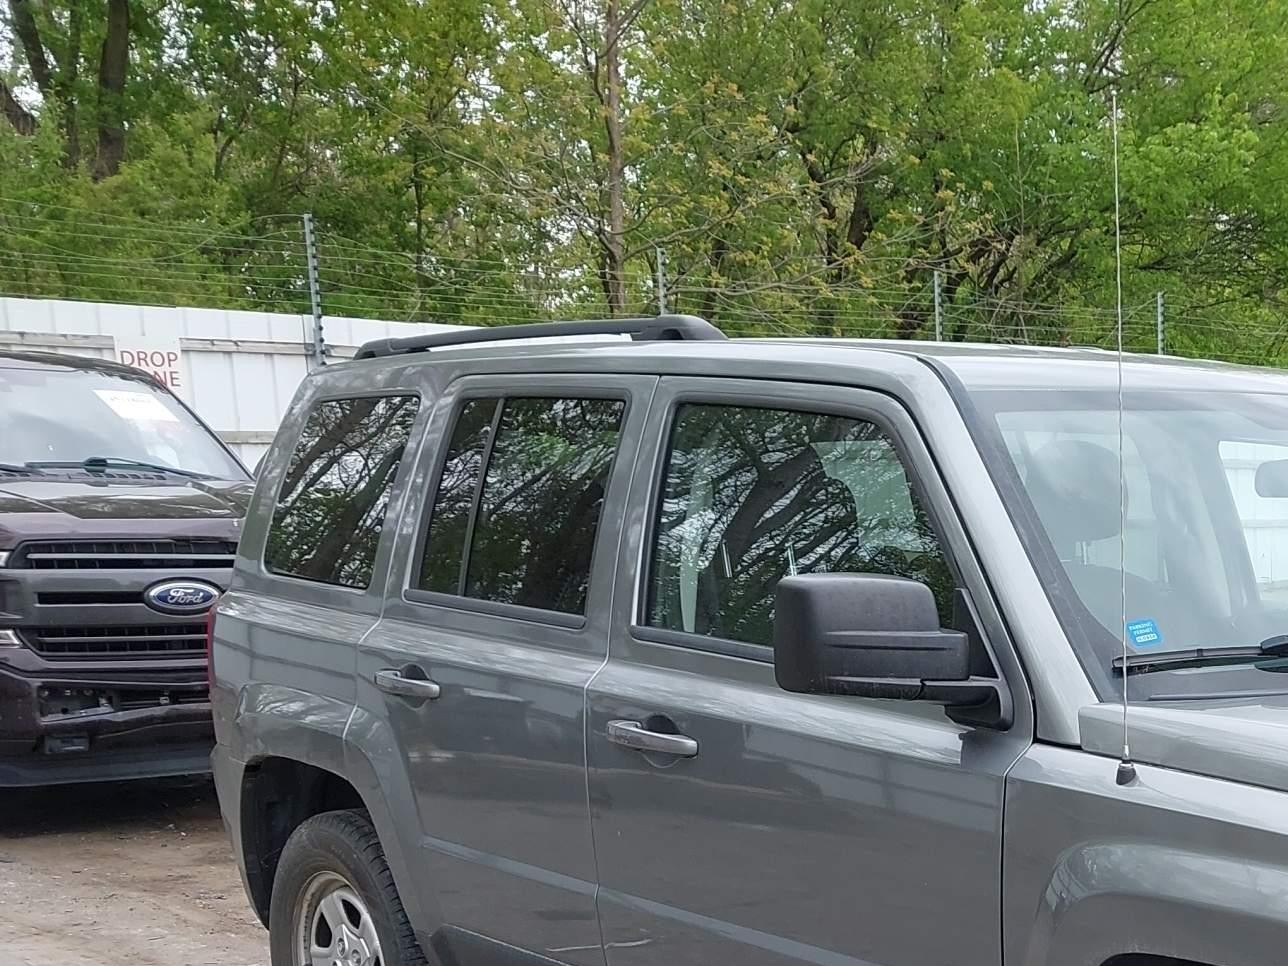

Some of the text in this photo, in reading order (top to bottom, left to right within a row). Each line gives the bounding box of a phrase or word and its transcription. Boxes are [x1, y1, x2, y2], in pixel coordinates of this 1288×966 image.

[120, 350, 178, 368] DROP
[152, 371, 181, 387] NE
[167, 588, 204, 603] Ford
